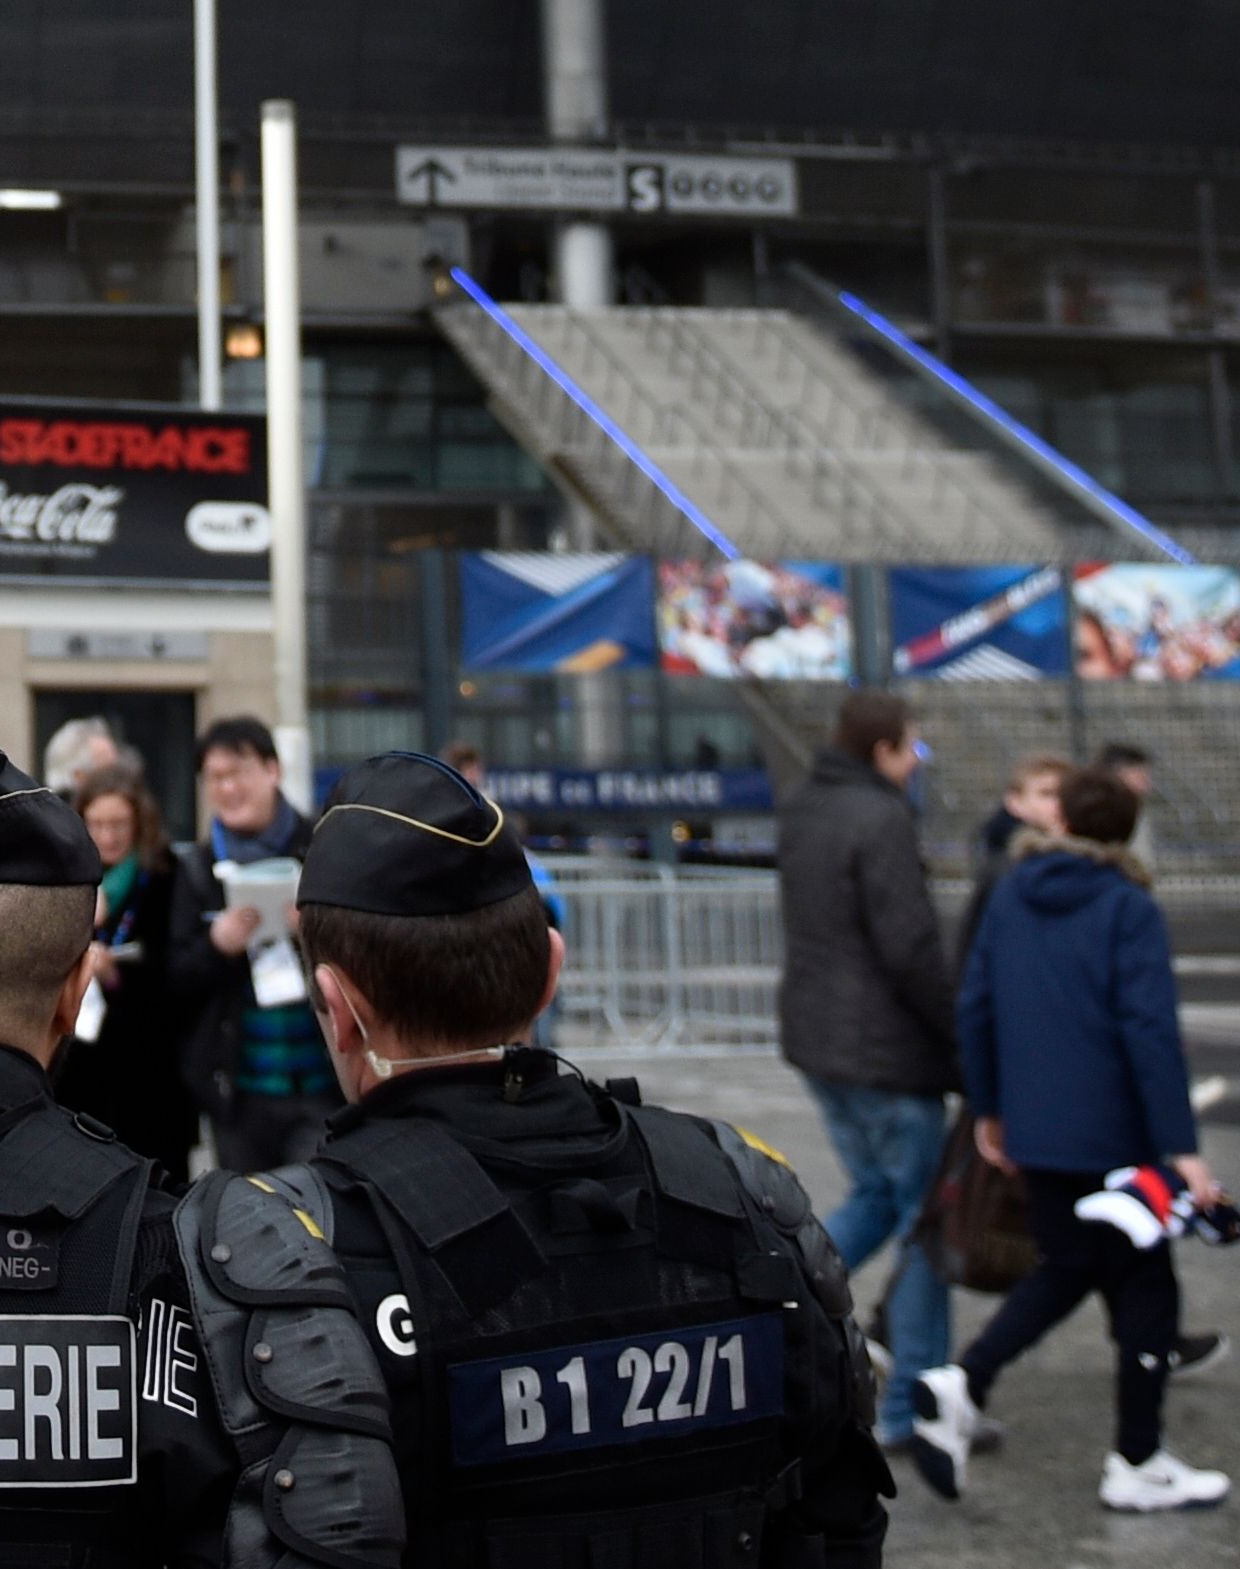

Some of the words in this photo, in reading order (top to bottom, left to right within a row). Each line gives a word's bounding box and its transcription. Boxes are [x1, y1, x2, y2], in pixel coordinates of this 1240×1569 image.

[630, 167, 659, 213] S
[596, 771, 720, 805] FRANCE
[376, 1294, 418, 1356] G
[142, 1298, 198, 1418] IE
[617, 1334, 746, 1429] 22/1
